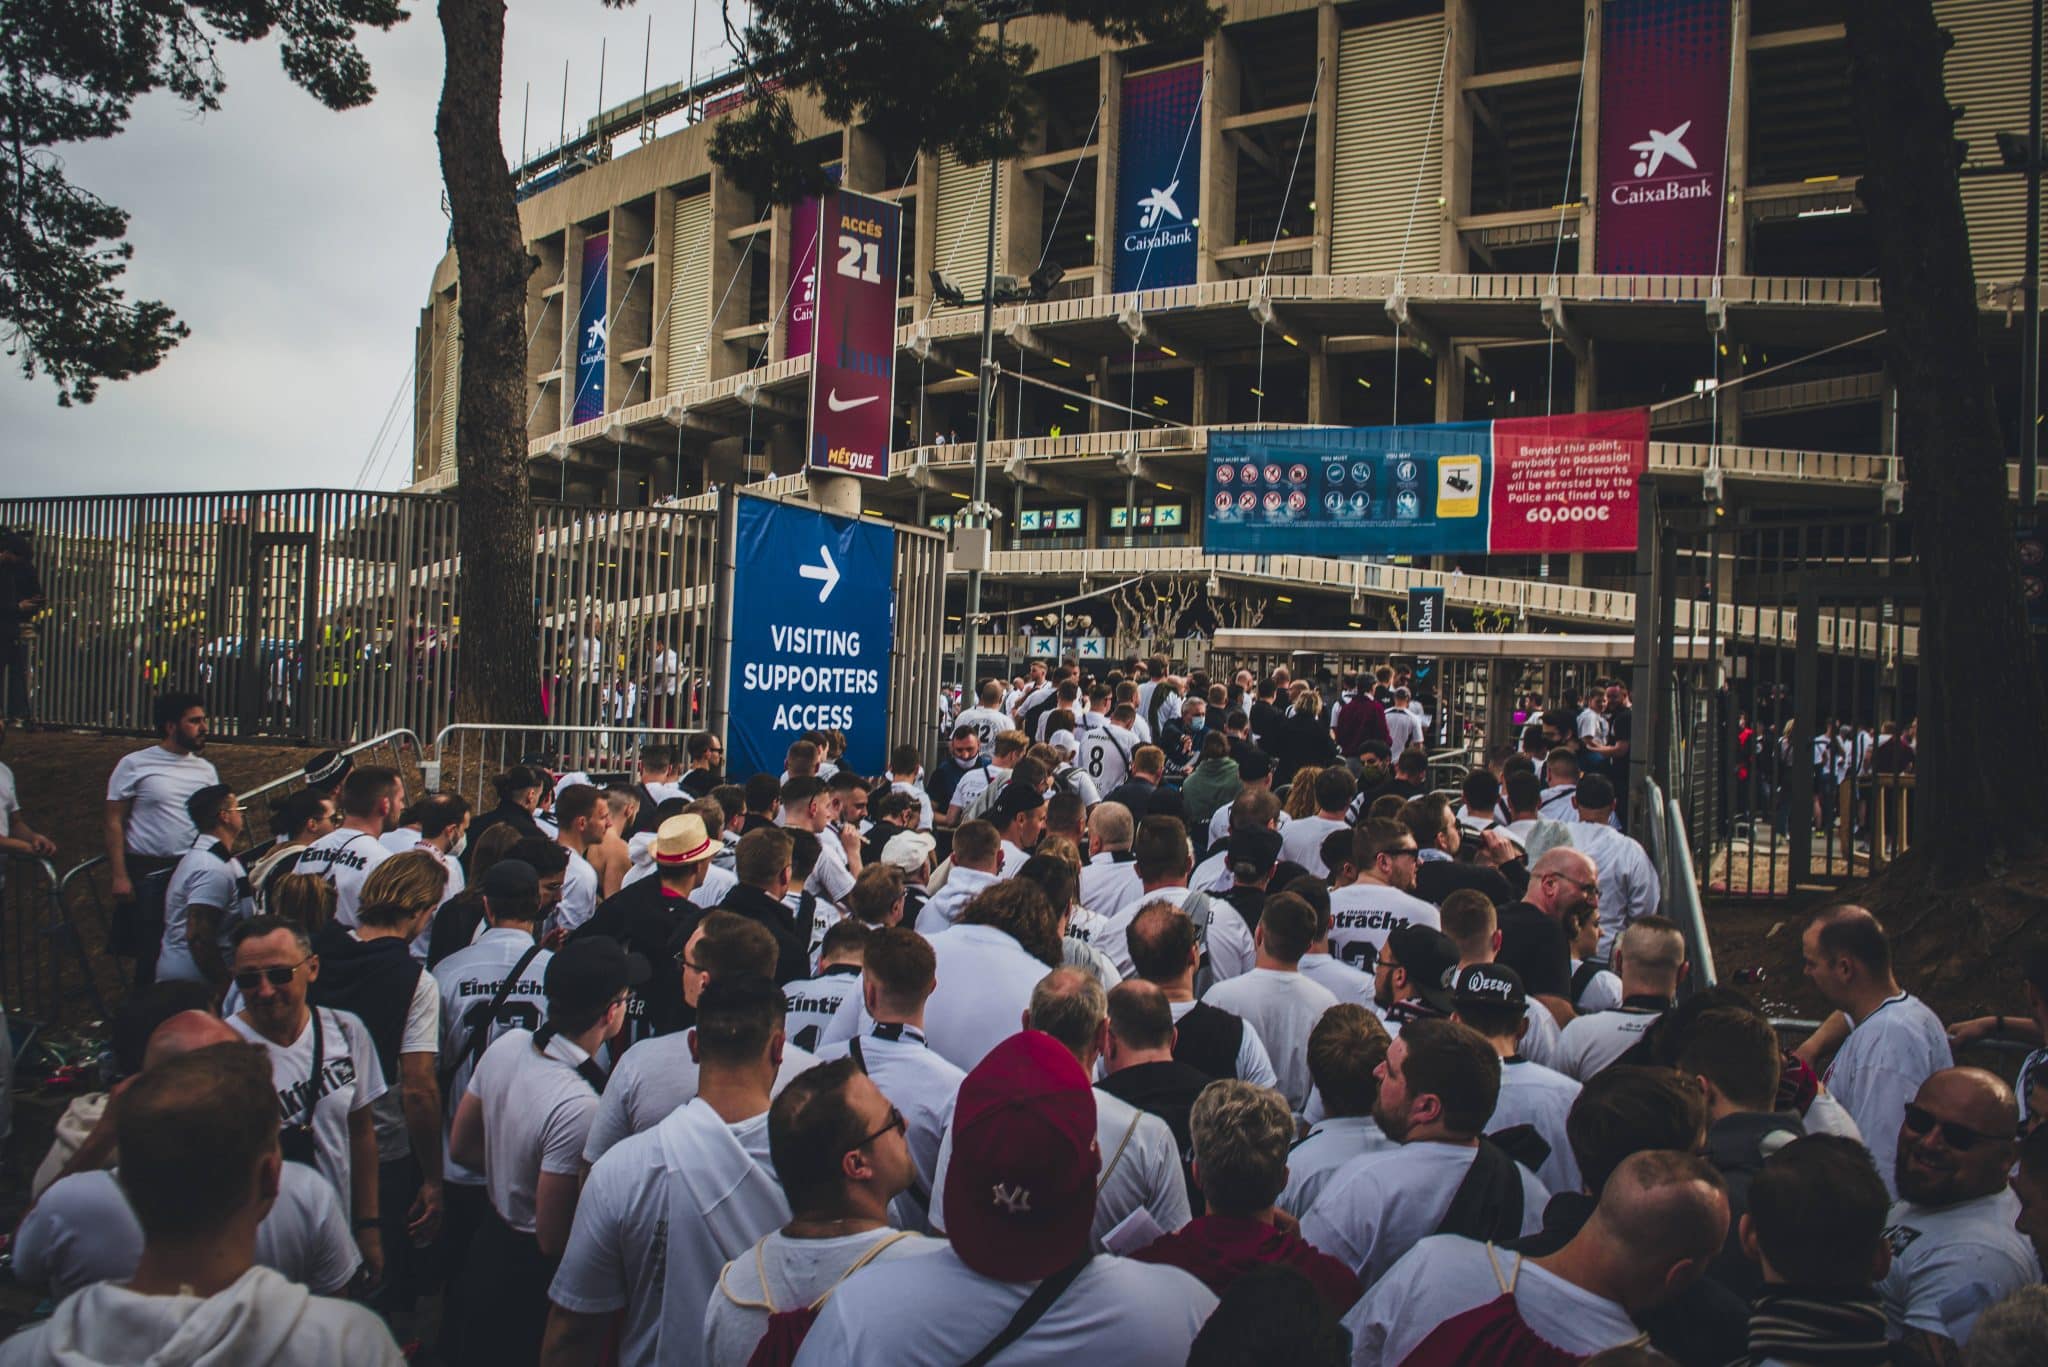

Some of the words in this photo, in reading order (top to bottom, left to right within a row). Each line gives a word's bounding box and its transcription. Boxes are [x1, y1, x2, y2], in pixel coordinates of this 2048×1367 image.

[1611, 178, 1712, 205] CaixaBank
[841, 215, 883, 239] ACCÉS
[1124, 228, 1192, 252] CaixaBank
[837, 235, 881, 285] 21
[1520, 445, 1561, 457] Beyond
[1564, 443, 1585, 454] this
[1511, 457, 1557, 469] anybody
[1560, 456, 1570, 465] in
[1512, 470, 1522, 480] of
[1525, 468, 1556, 479] flares
[1560, 468, 1571, 477] or
[1575, 465, 1628, 477] fireworks
[1507, 481, 1525, 491] will
[1528, 480, 1542, 490] be
[1545, 479, 1592, 490] arrested
[1595, 478, 1609, 489] by
[1613, 477, 1632, 487] the
[1508, 493, 1542, 504] Police
[1545, 491, 1564, 502] and
[1568, 490, 1597, 501] fined
[1600, 491, 1613, 501] up
[1618, 489, 1630, 499] to
[1525, 505, 1610, 524] 60,000€
[770, 624, 860, 657] VISITING
[743, 663, 878, 695] SUPPORTERS
[772, 703, 853, 731] ACCESS
[1088, 745, 1104, 778] 8
